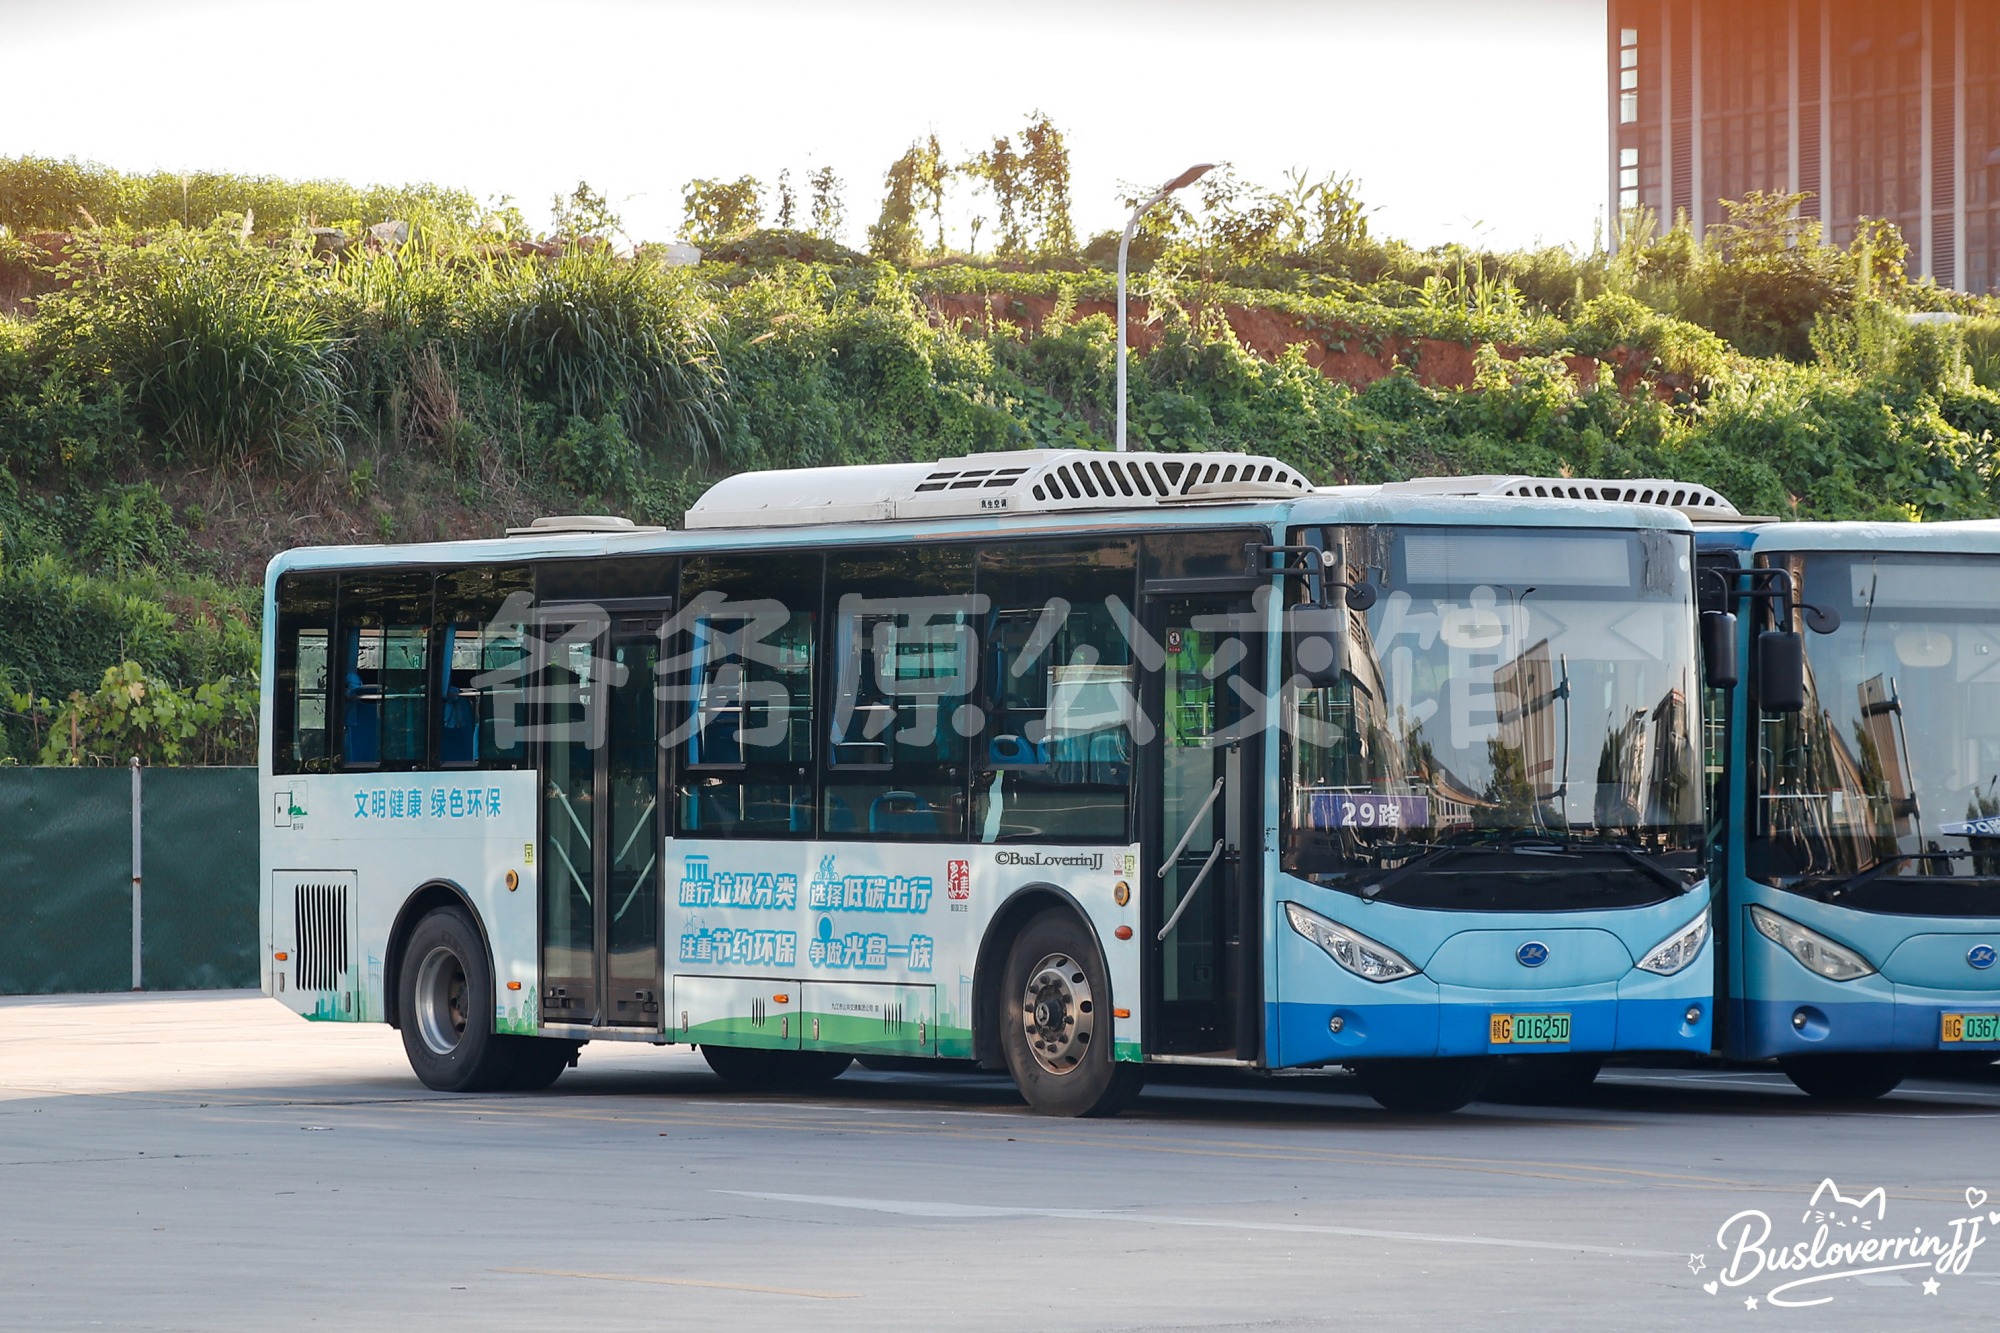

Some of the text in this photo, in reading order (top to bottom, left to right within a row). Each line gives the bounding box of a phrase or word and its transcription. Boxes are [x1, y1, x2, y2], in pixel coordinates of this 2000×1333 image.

[354, 787, 502, 819] 文明健康 绿色环保
[1341, 802, 1400, 827] 29路
[679, 872, 797, 910] 推行垃圾分类
[809, 875, 933, 913] 选择低碳出行
[680, 928, 797, 967] 注重节约环保
[808, 932, 934, 973] 争做光盘一族
